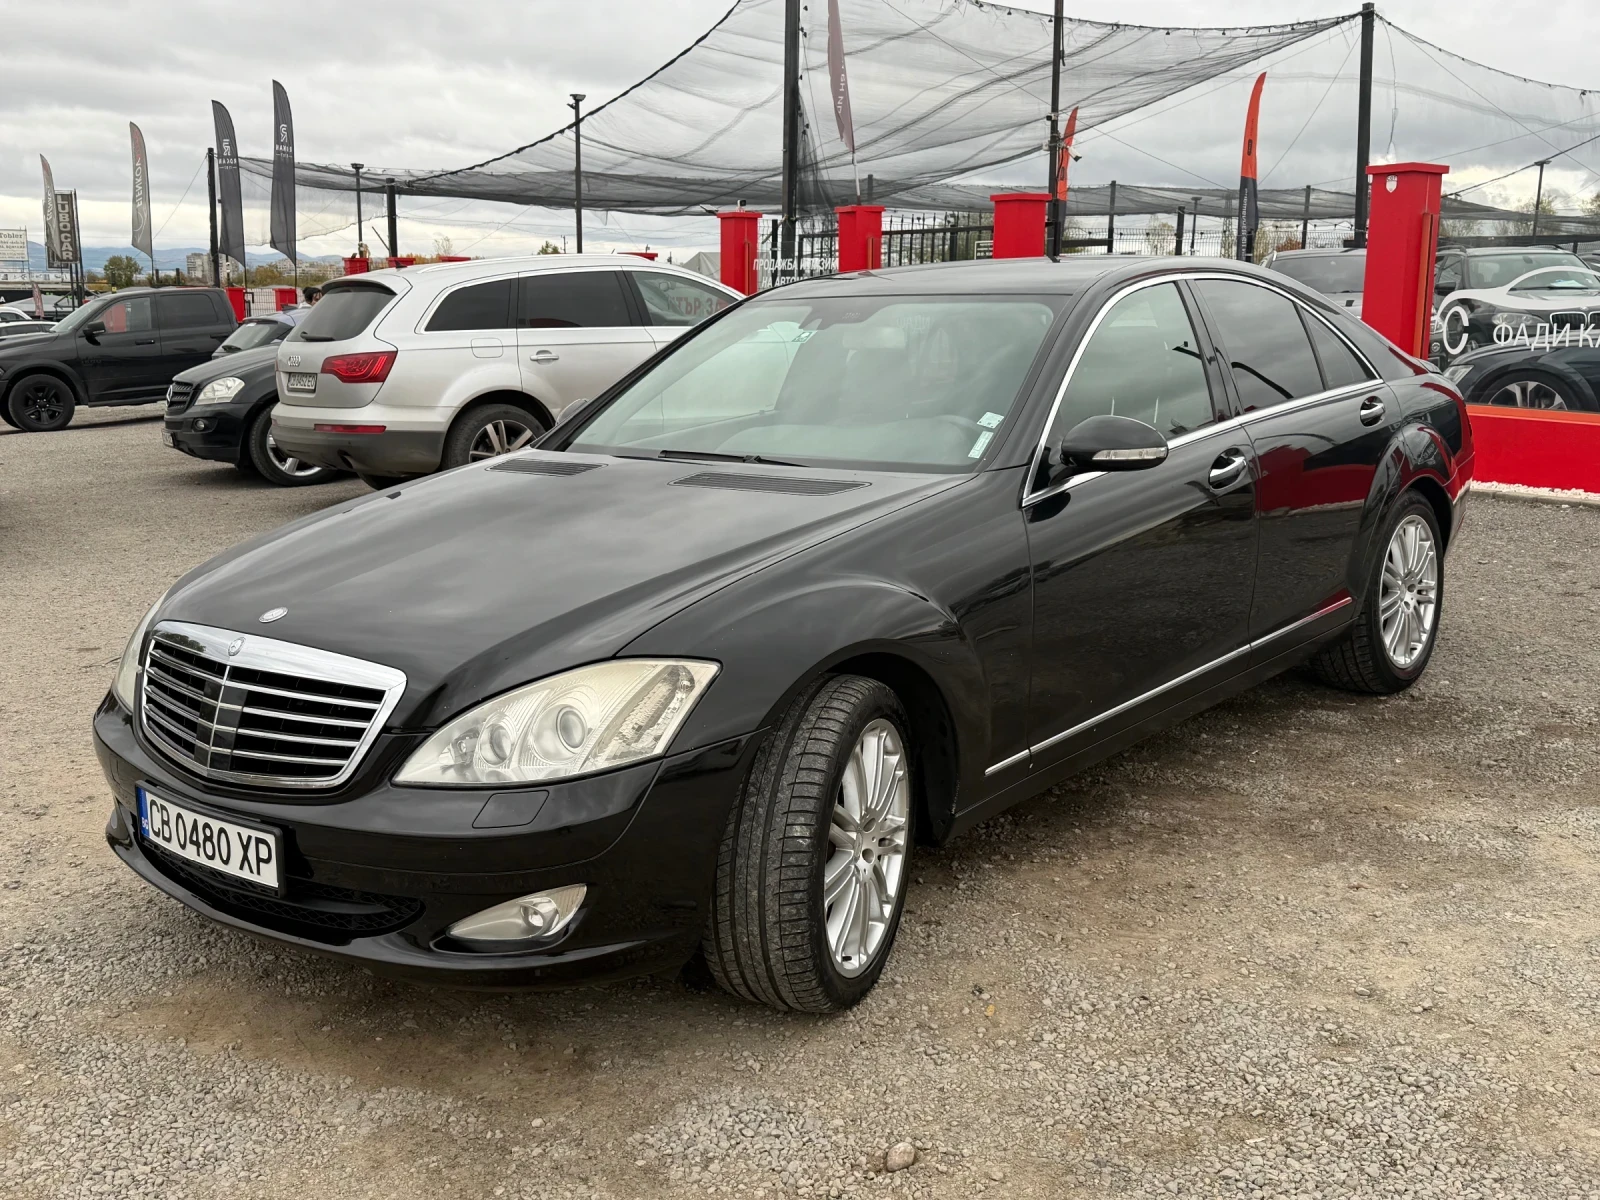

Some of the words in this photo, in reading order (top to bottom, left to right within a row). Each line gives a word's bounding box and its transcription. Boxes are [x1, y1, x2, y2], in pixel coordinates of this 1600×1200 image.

[1493, 323, 1570, 352] ФАДИ
[141, 816, 149, 830] BG
[150, 799, 172, 843] CB
[176, 812, 231, 866] 0480
[237, 831, 273, 876] XP
